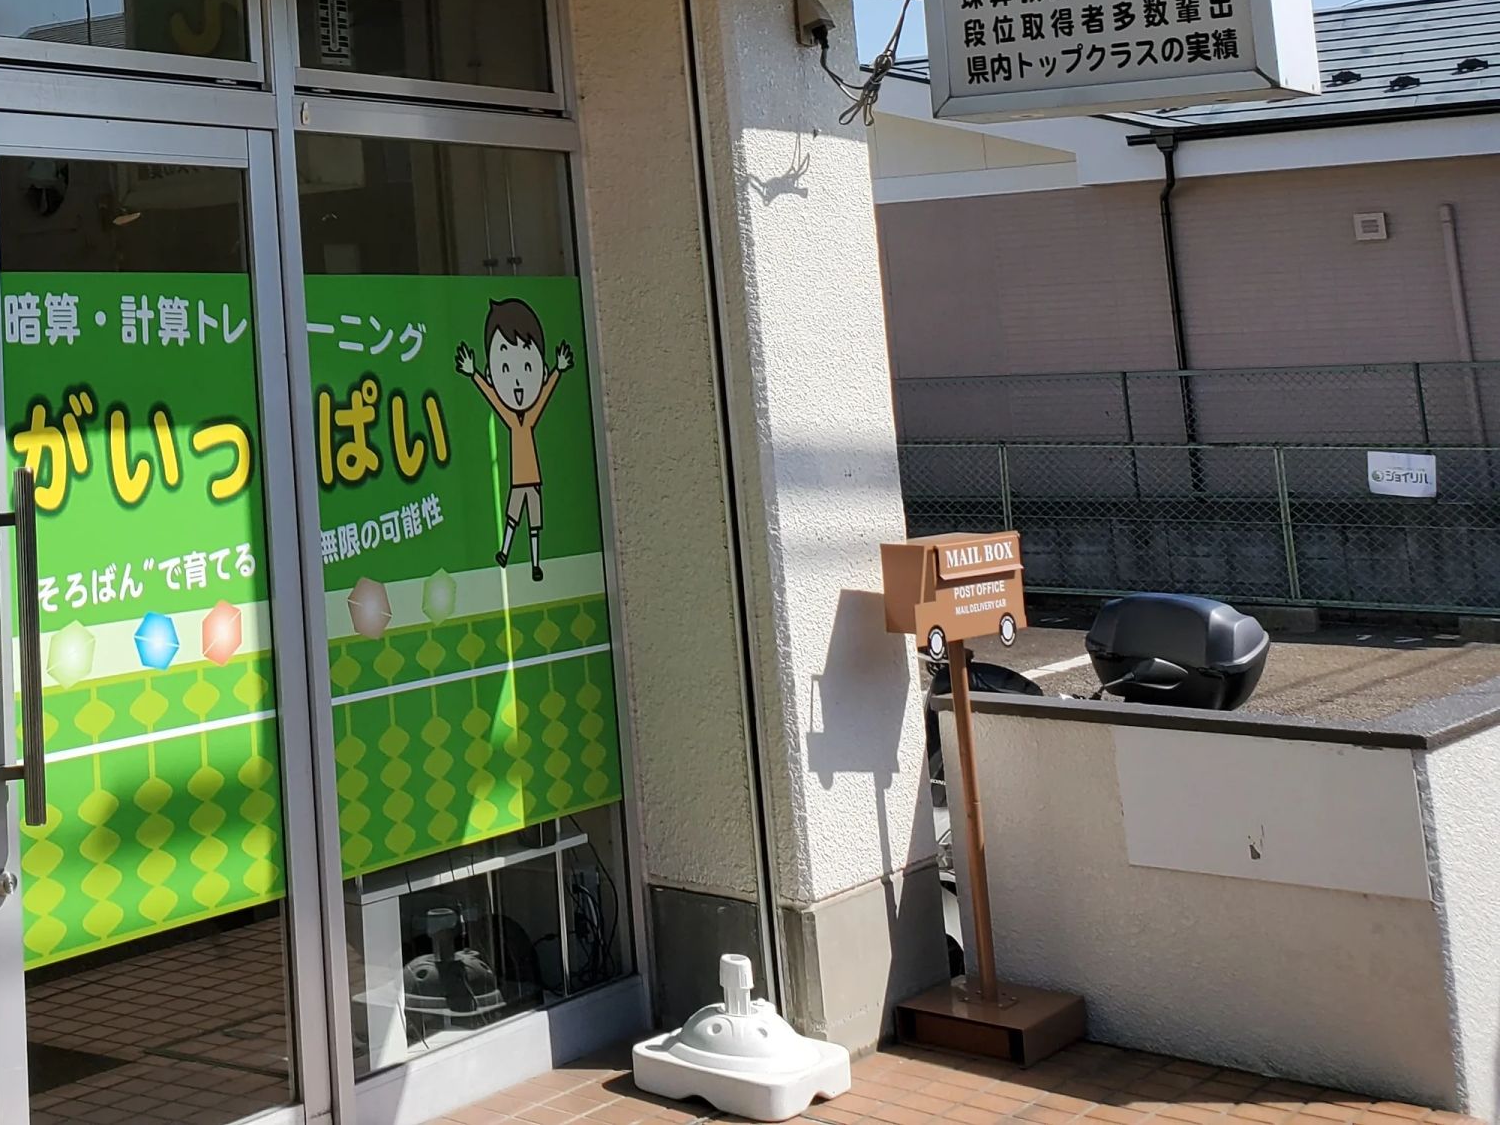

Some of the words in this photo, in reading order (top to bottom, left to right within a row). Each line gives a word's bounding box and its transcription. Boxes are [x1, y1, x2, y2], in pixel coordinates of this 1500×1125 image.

[966, 28, 1240, 86] 県内トップクラスの実績
[4, 292, 248, 347] 暗算・計算トレ
[305, 314, 427, 362] ーニング
[13, 392, 250, 511] がいっ
[318, 379, 448, 485] ぱい
[320, 493, 445, 565] 無限の可能性
[945, 546, 982, 568] MAIL
[984, 541, 1014, 562] BOX
[954, 584, 975, 600] POST
[976, 580, 1005, 595] OFFICE
